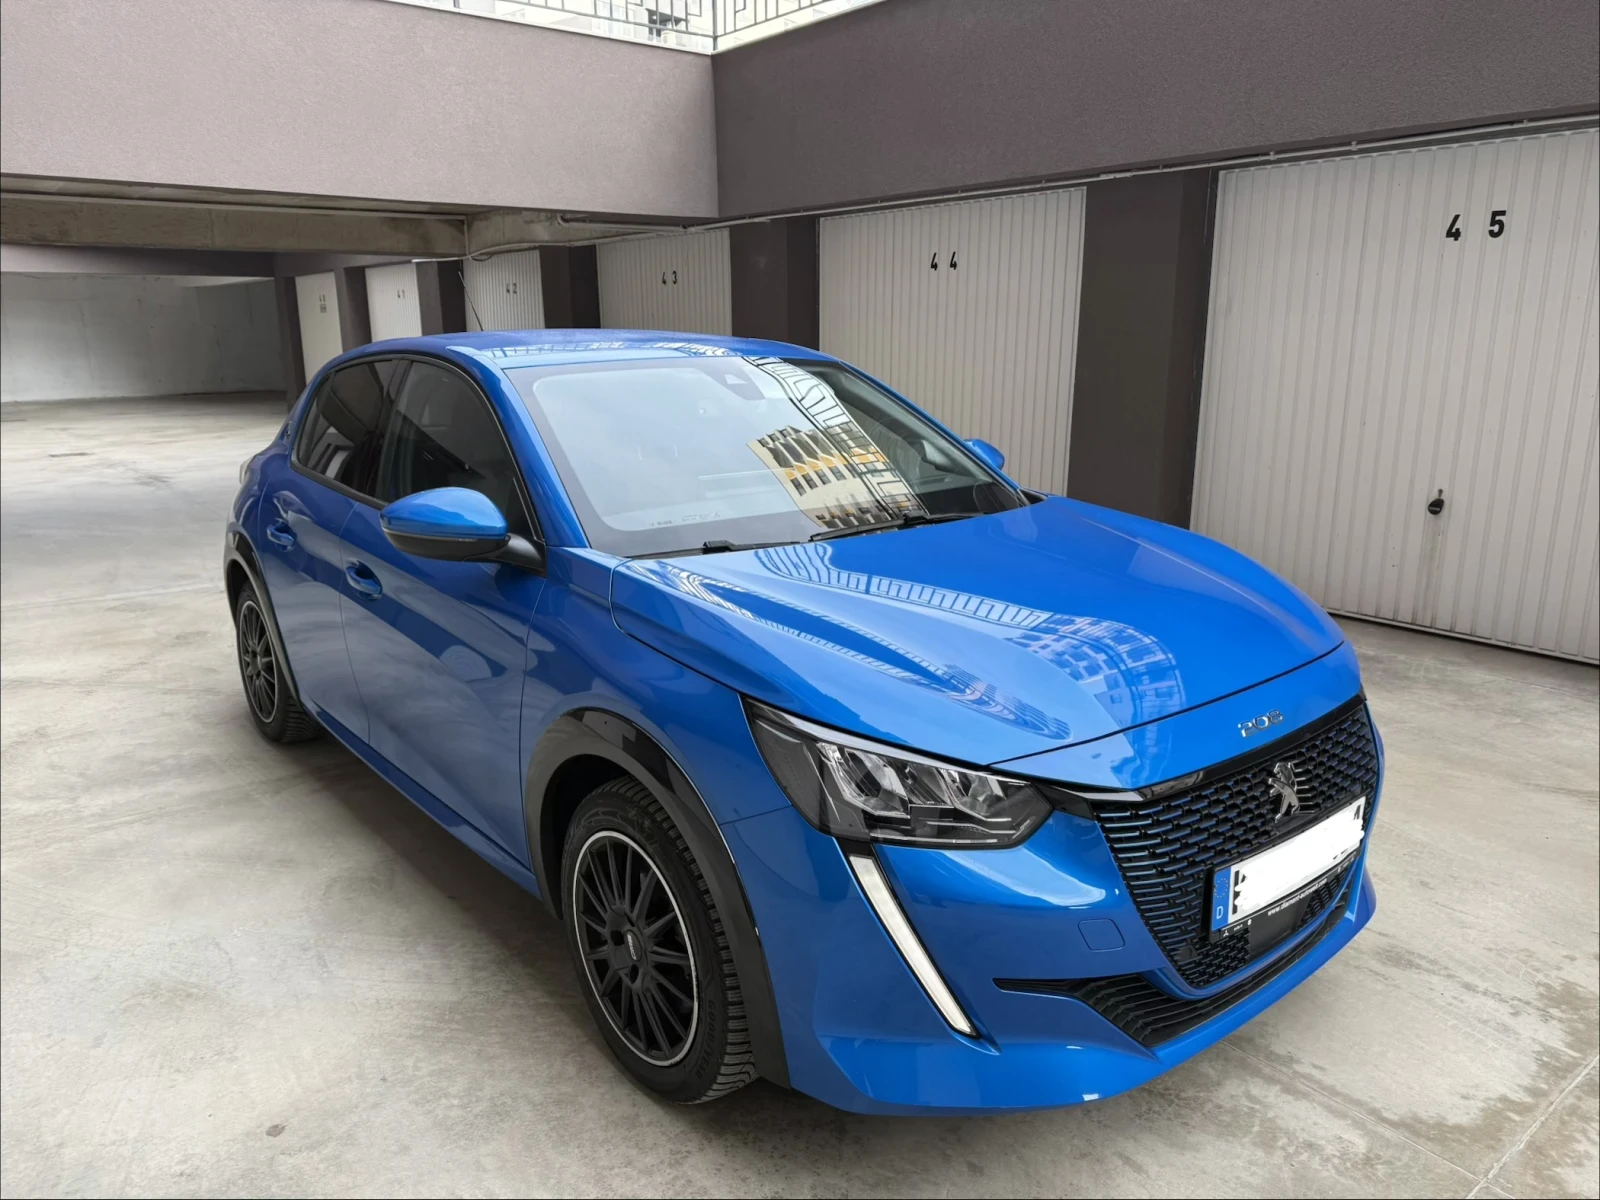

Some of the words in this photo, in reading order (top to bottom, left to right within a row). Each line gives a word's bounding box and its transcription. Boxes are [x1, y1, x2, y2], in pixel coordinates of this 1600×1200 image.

[1237, 709, 1283, 738] 208
[1216, 906, 1224, 919] D
[693, 999, 717, 1079] GOODYEAR
